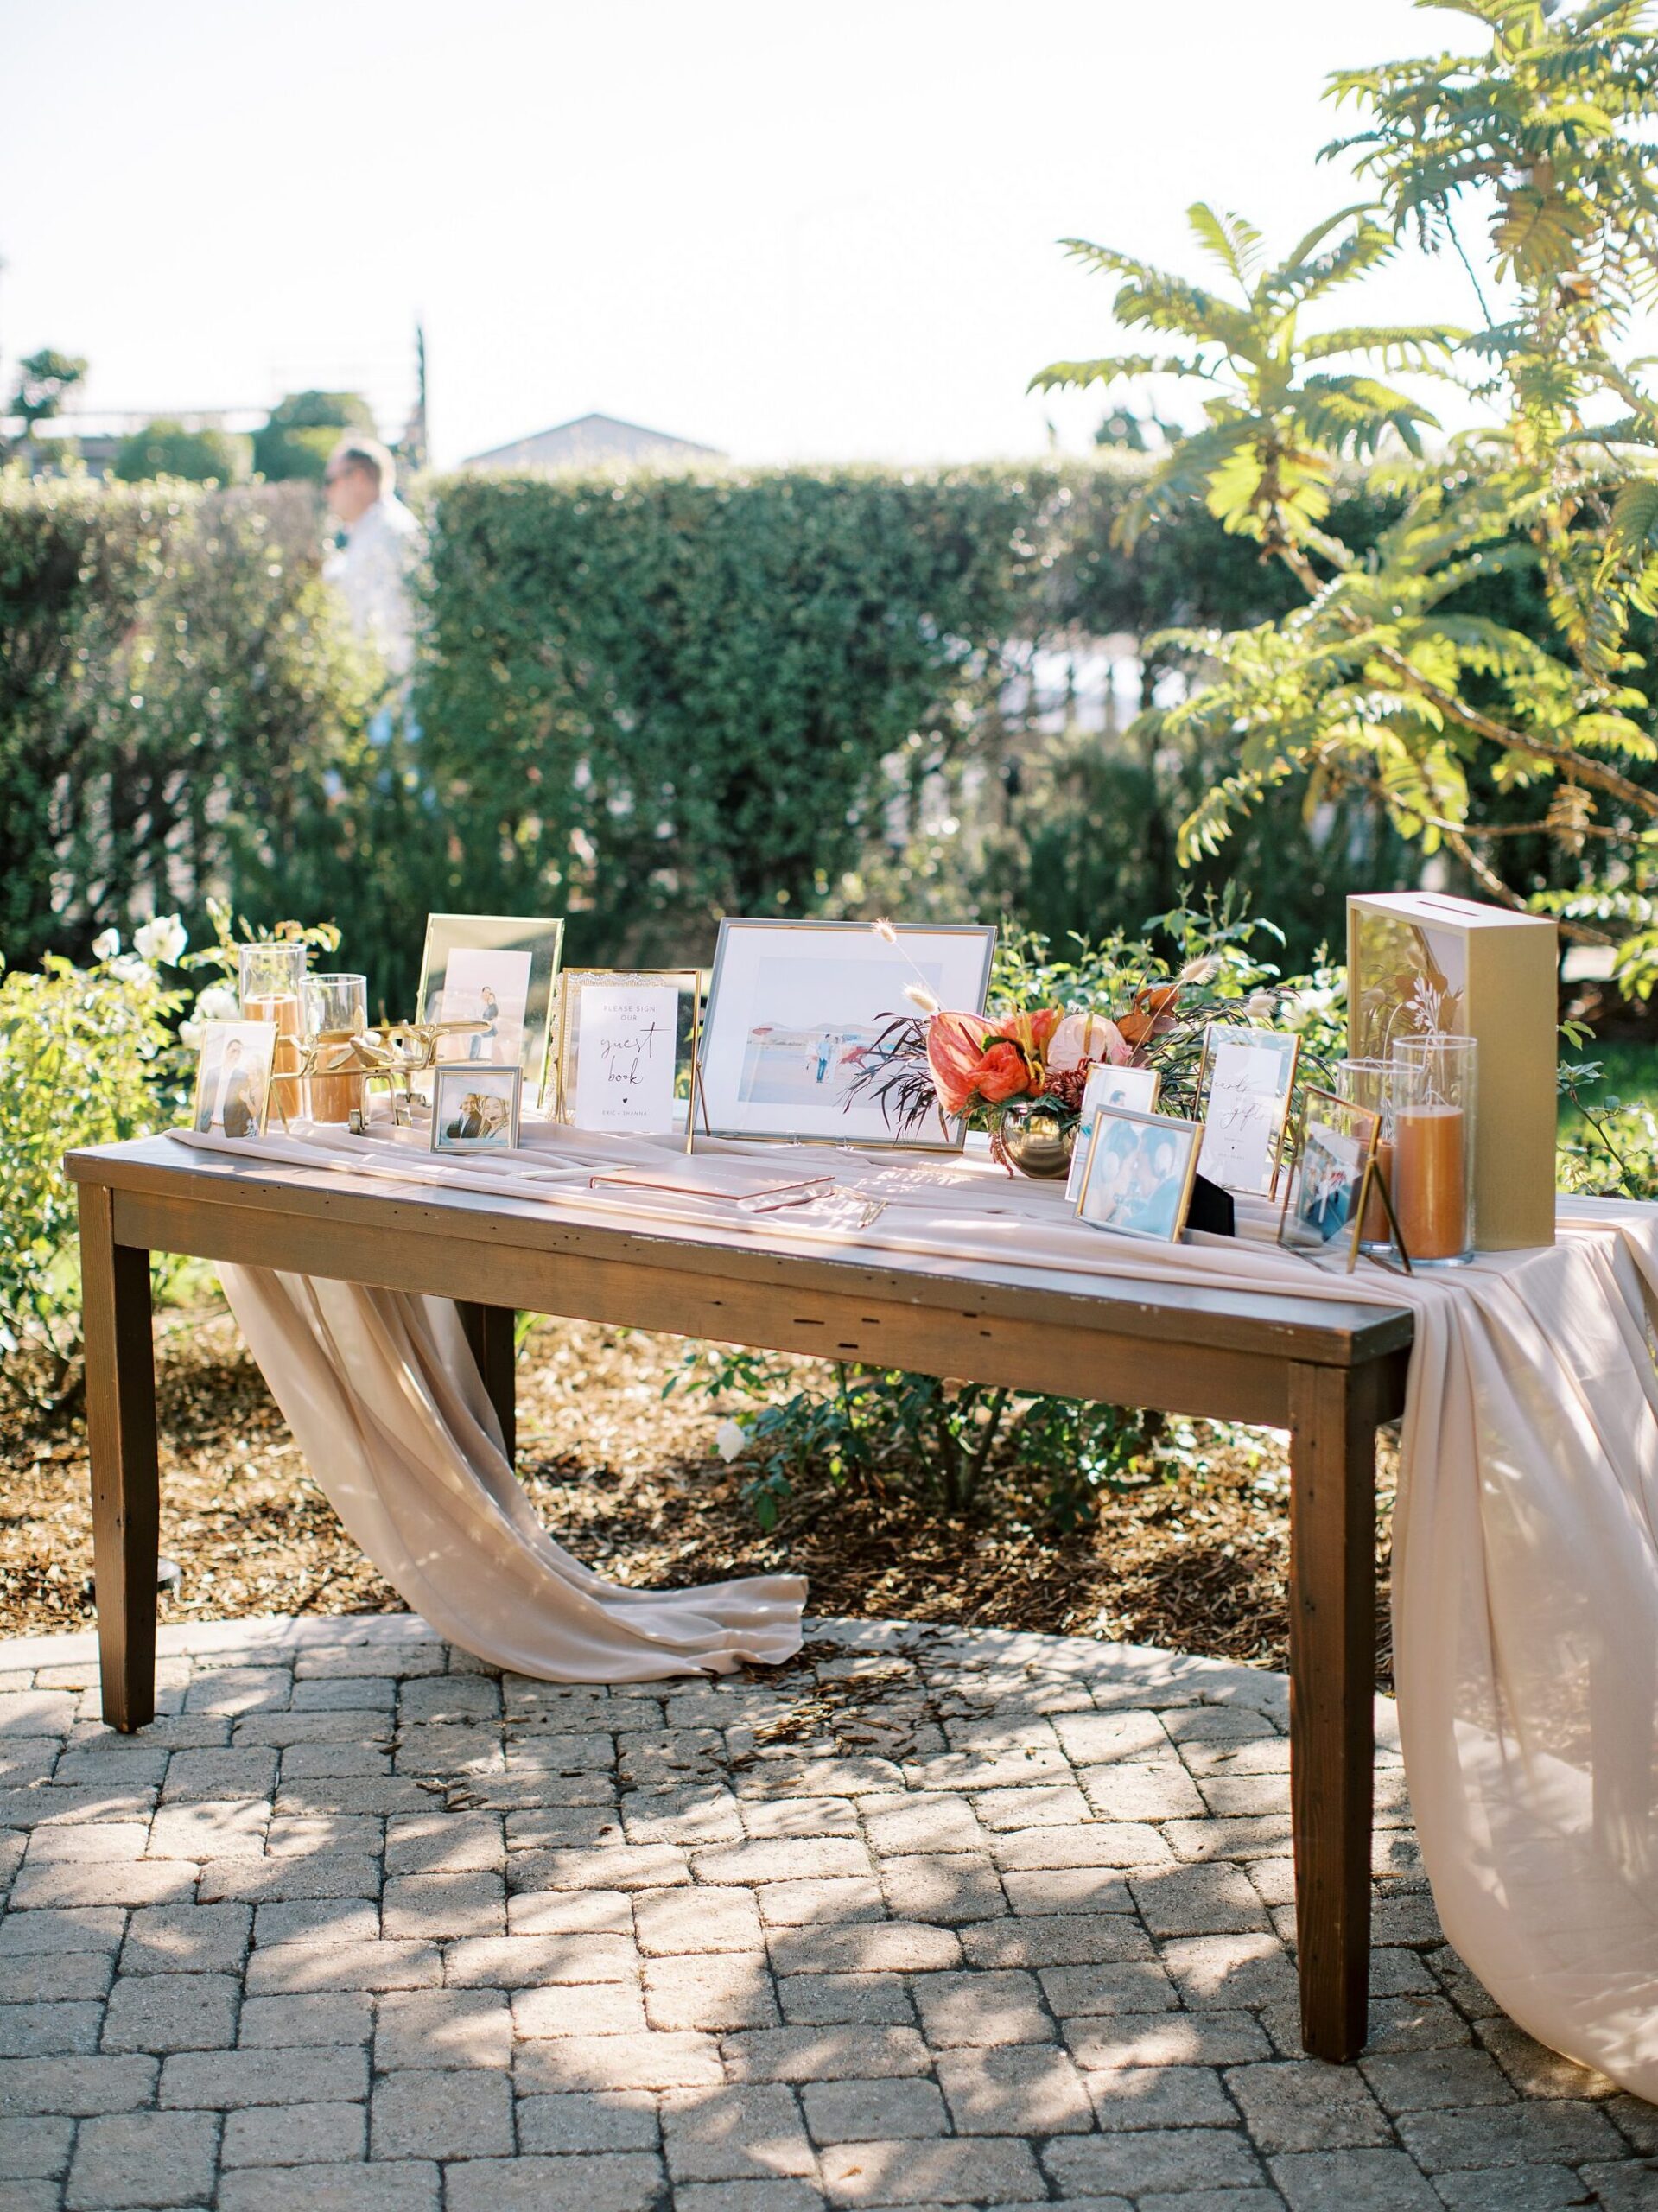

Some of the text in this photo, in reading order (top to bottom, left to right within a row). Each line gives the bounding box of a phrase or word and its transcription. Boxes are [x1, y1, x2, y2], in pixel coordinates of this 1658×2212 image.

[600, 1021, 671, 1058] guest
[607, 1055, 644, 1085] book
[1220, 1103, 1268, 1133] gifts
